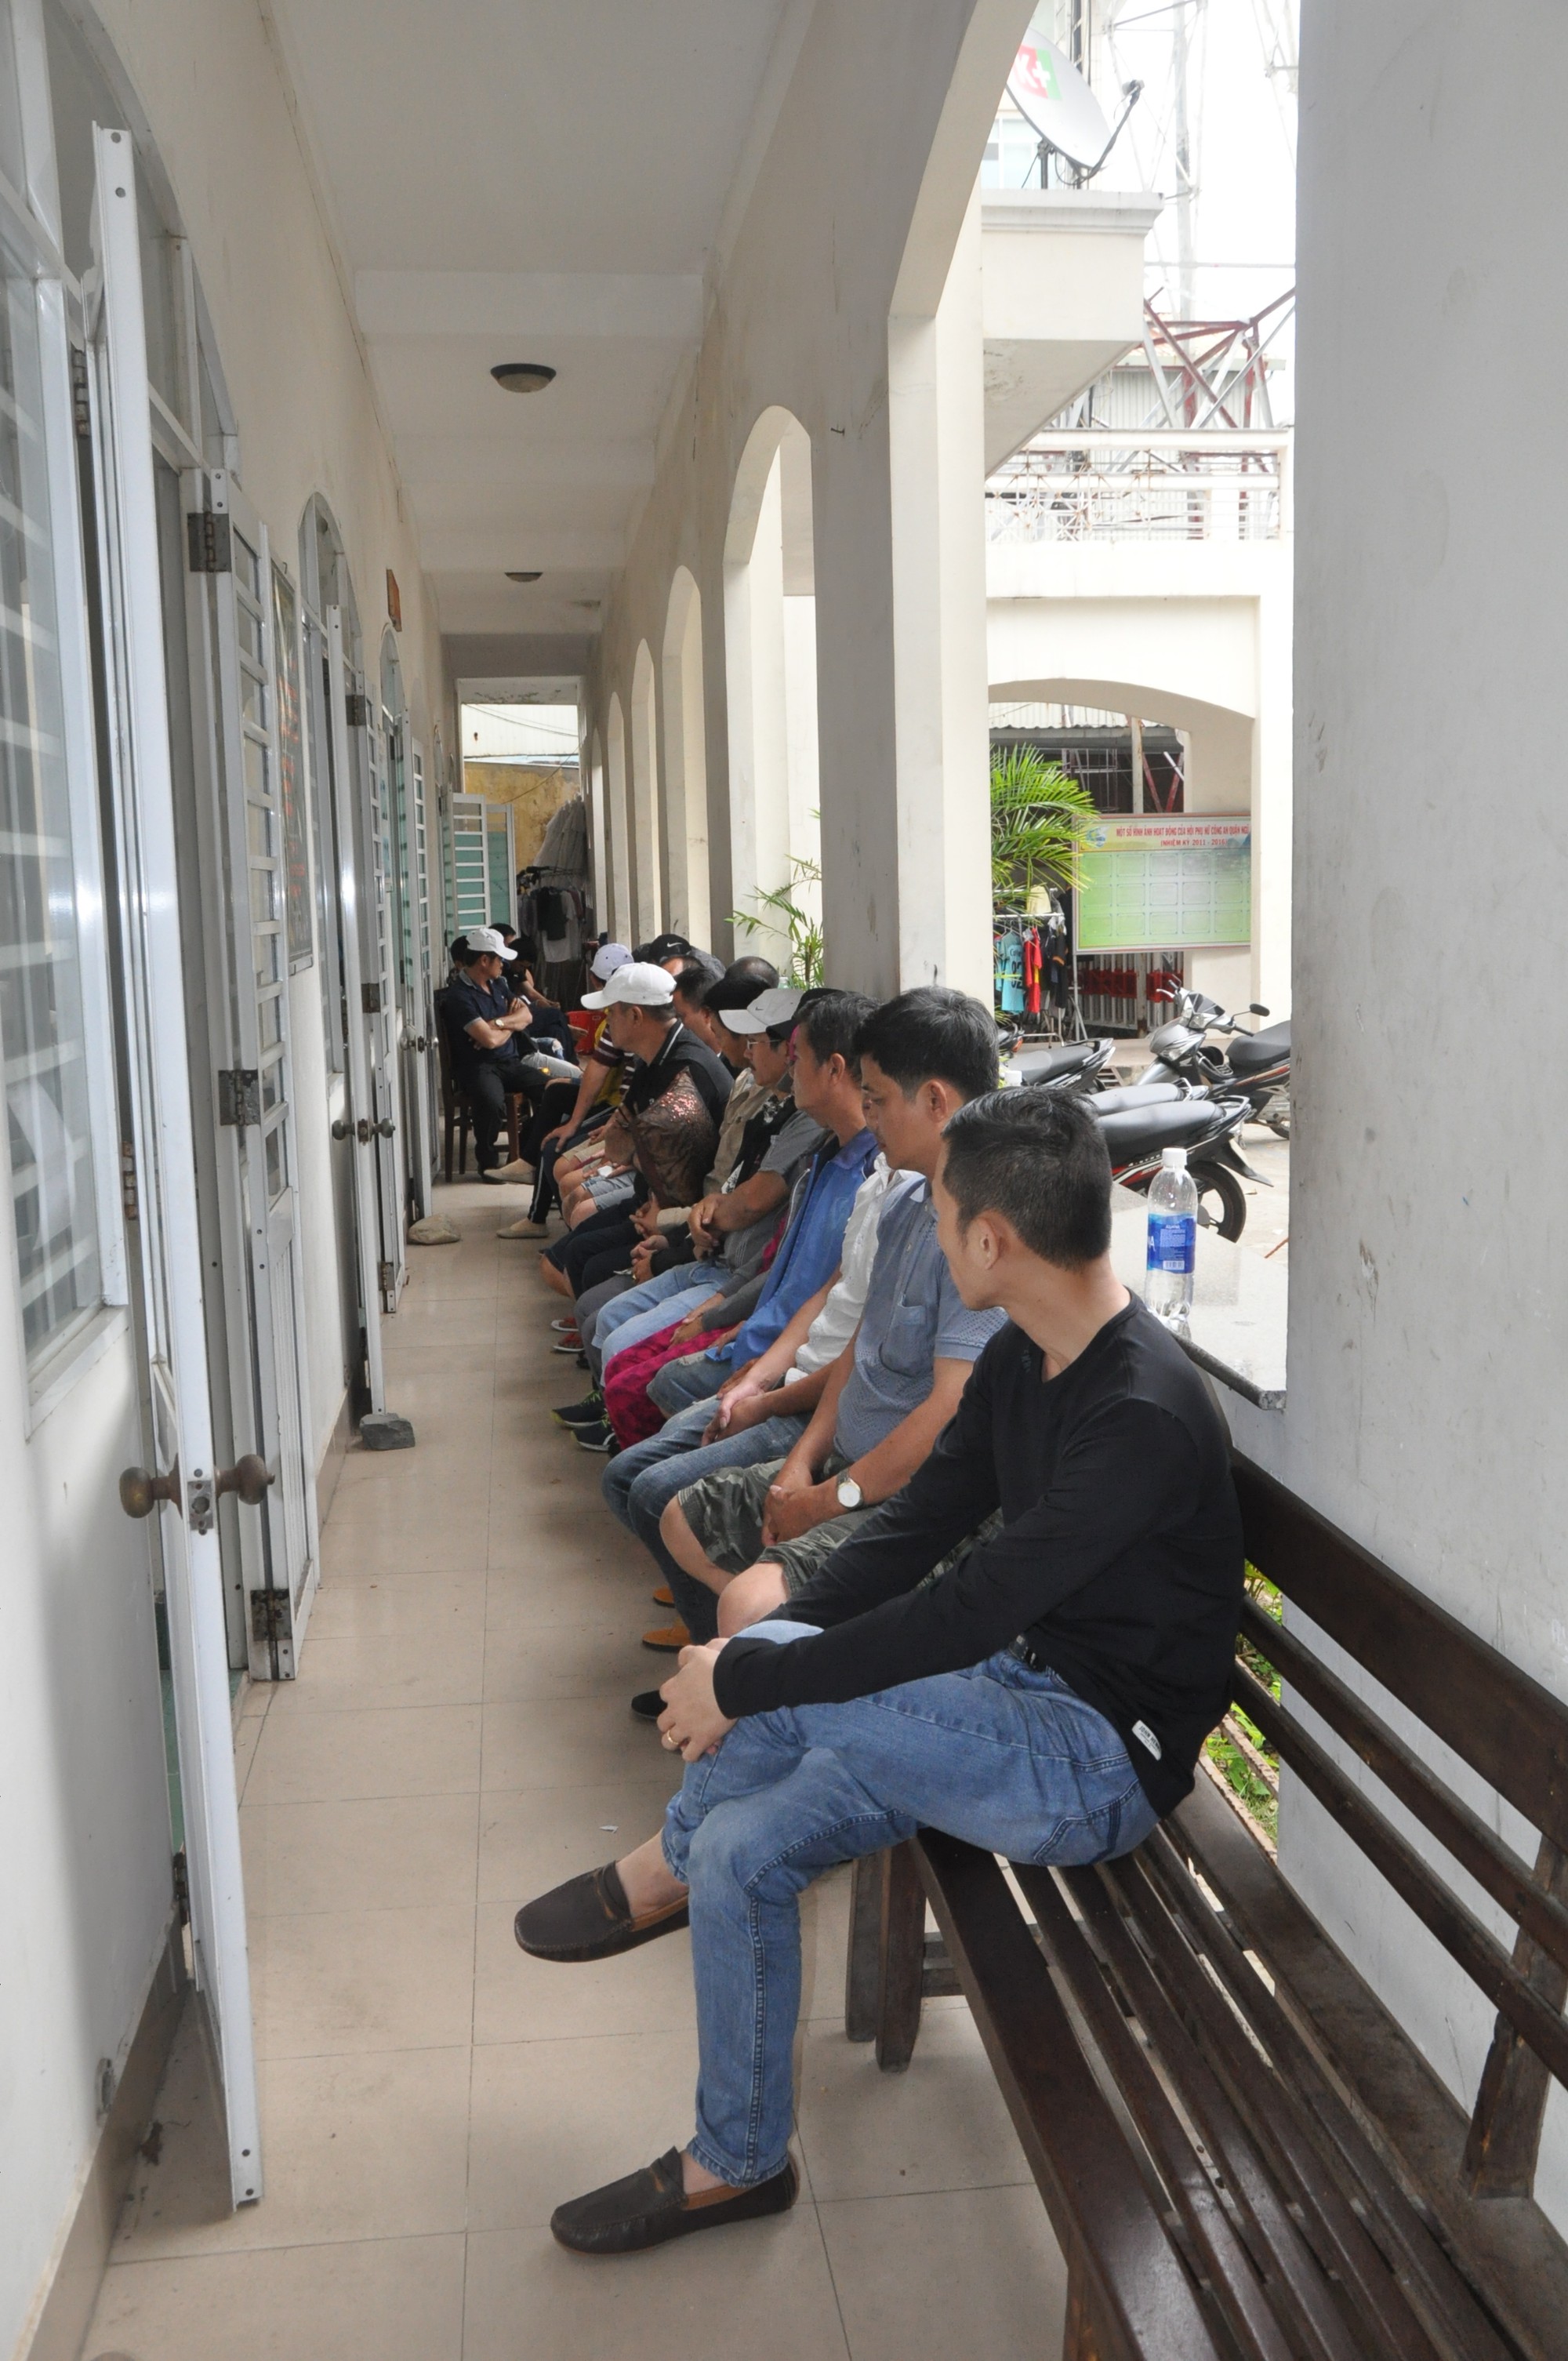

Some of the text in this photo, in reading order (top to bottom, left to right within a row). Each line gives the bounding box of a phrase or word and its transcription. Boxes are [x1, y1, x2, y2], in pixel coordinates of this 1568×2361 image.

[1116, 826, 1125, 837] MỘT
[1126, 824, 1132, 837] SỐ
[1133, 825, 1143, 837] HÌNH
[1144, 825, 1152, 836] ẢNH
[1153, 827, 1164, 837] HOẠT
[1165, 825, 1177, 837] ĐỘNG
[1178, 823, 1186, 836] CỦA
[1195, 826, 1203, 837] PHỤ
[1204, 824, 1210, 835] NỮ
[1211, 824, 1222, 835] CÔNG
[1223, 826, 1229, 835] AN
[1229, 824, 1240, 836] QUẬN
[1161, 838, 1181, 847] (NHIỆM
